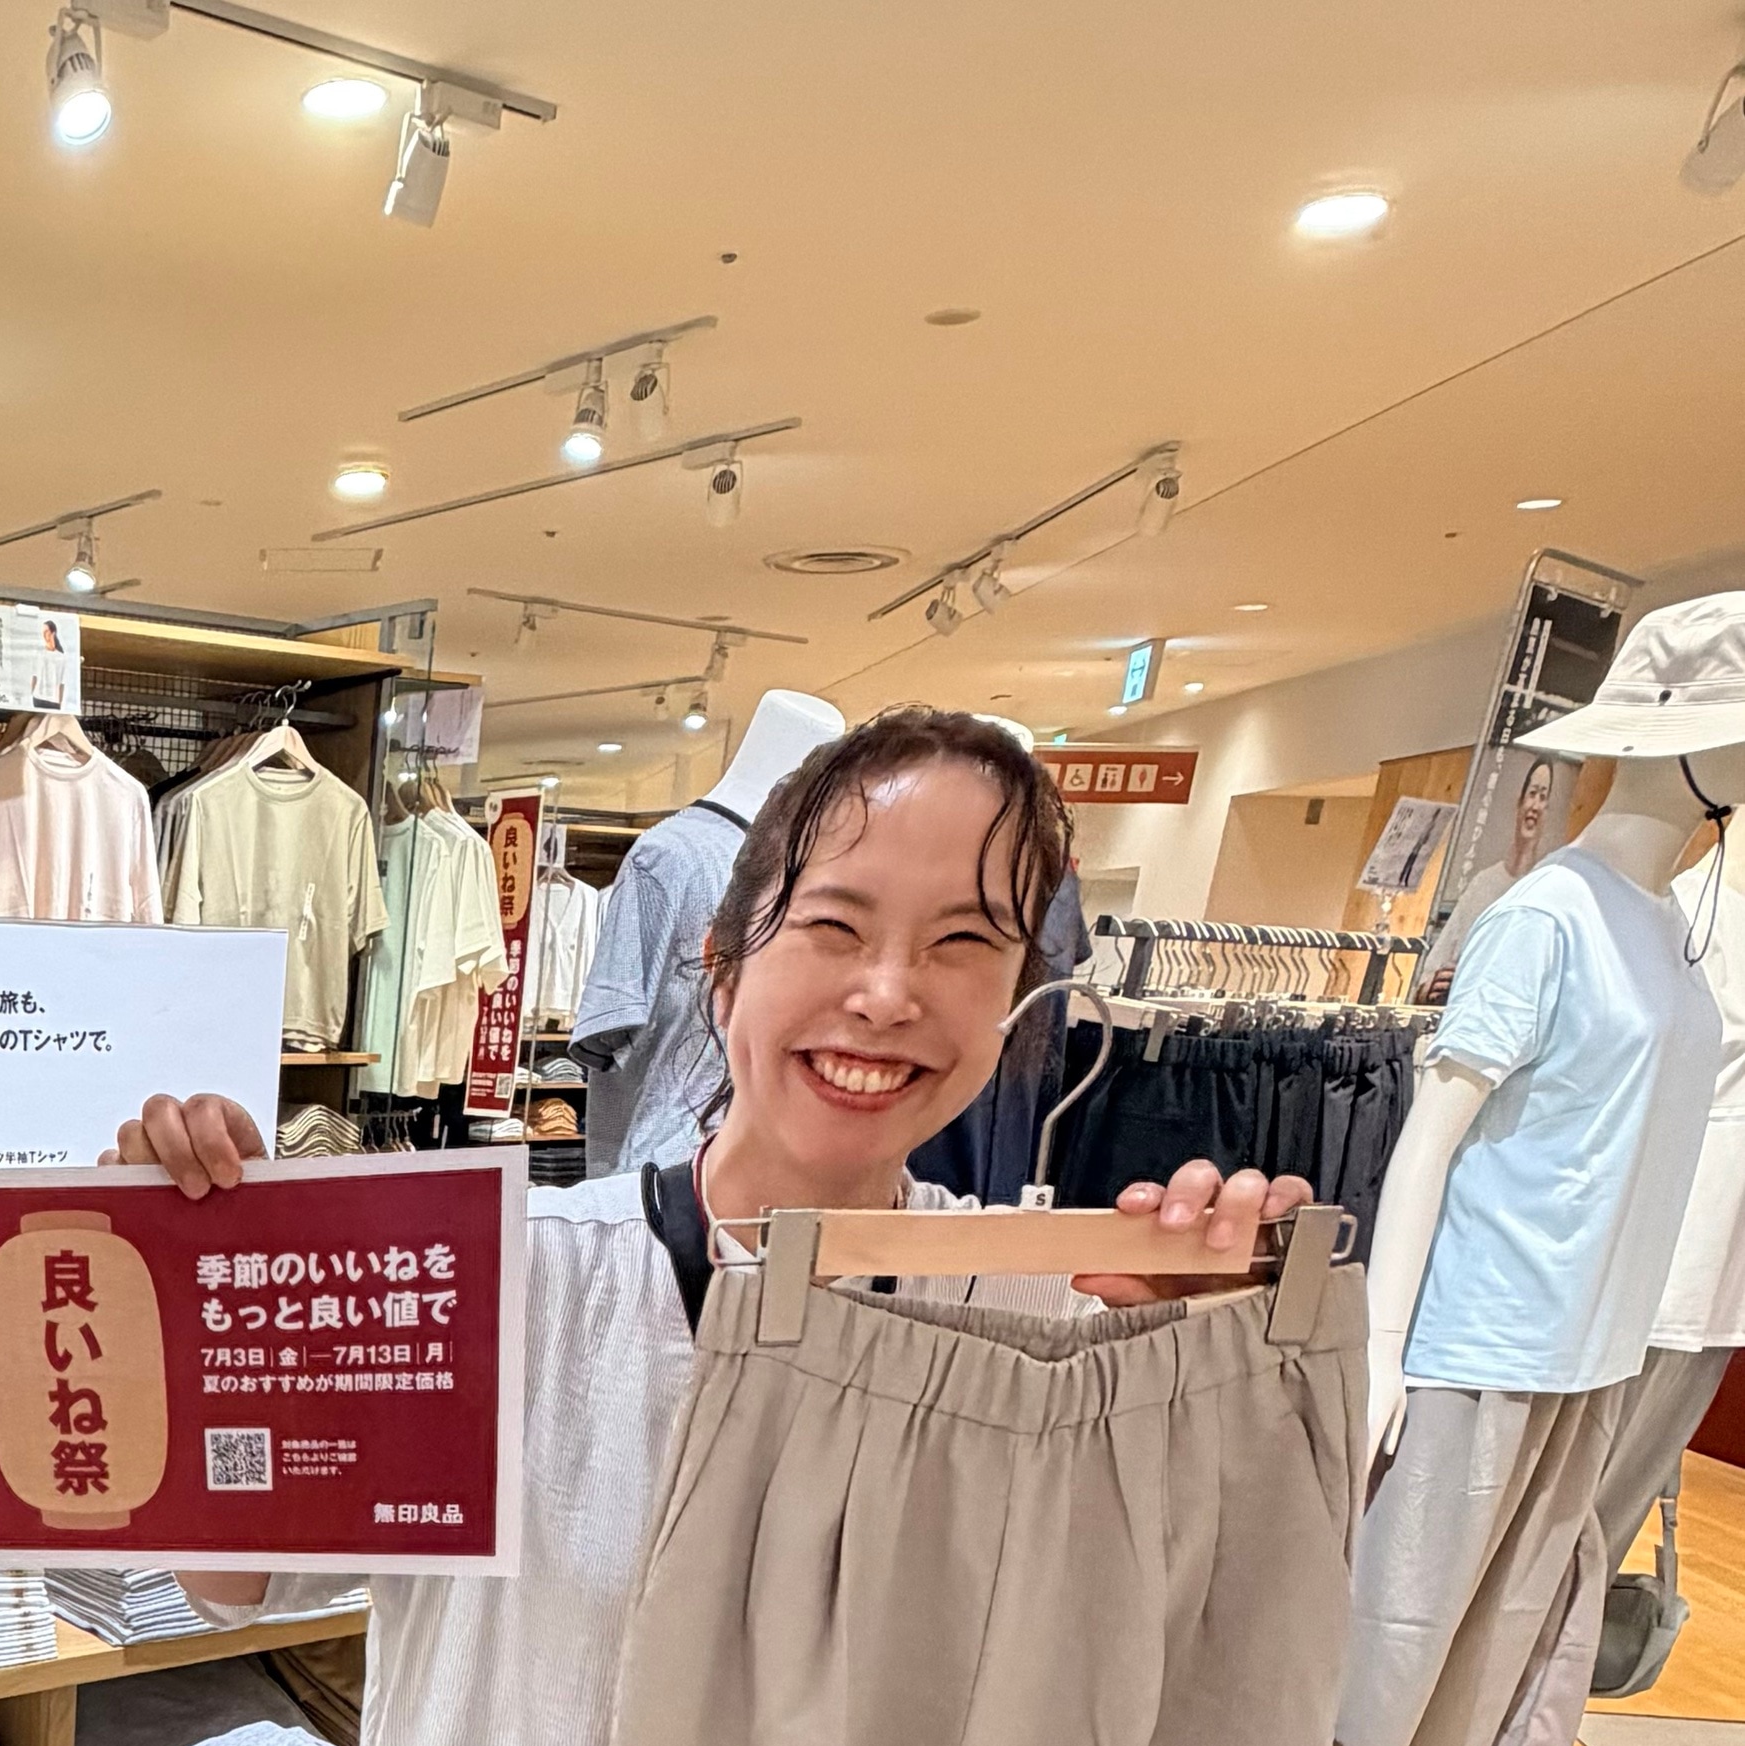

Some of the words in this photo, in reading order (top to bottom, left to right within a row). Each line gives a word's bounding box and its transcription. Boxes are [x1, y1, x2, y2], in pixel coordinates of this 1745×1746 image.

[500, 825, 518, 917] 良いね祭
[1035, 1192, 1047, 1207] S
[196, 1243, 457, 1291] 季節のいいねを
[201, 1289, 458, 1332] もっと良い値で
[40, 1249, 110, 1497] 良いね祭
[202, 1371, 455, 1395] 夏のおすすめが期間限定価格
[373, 1502, 465, 1525] 無印良品
